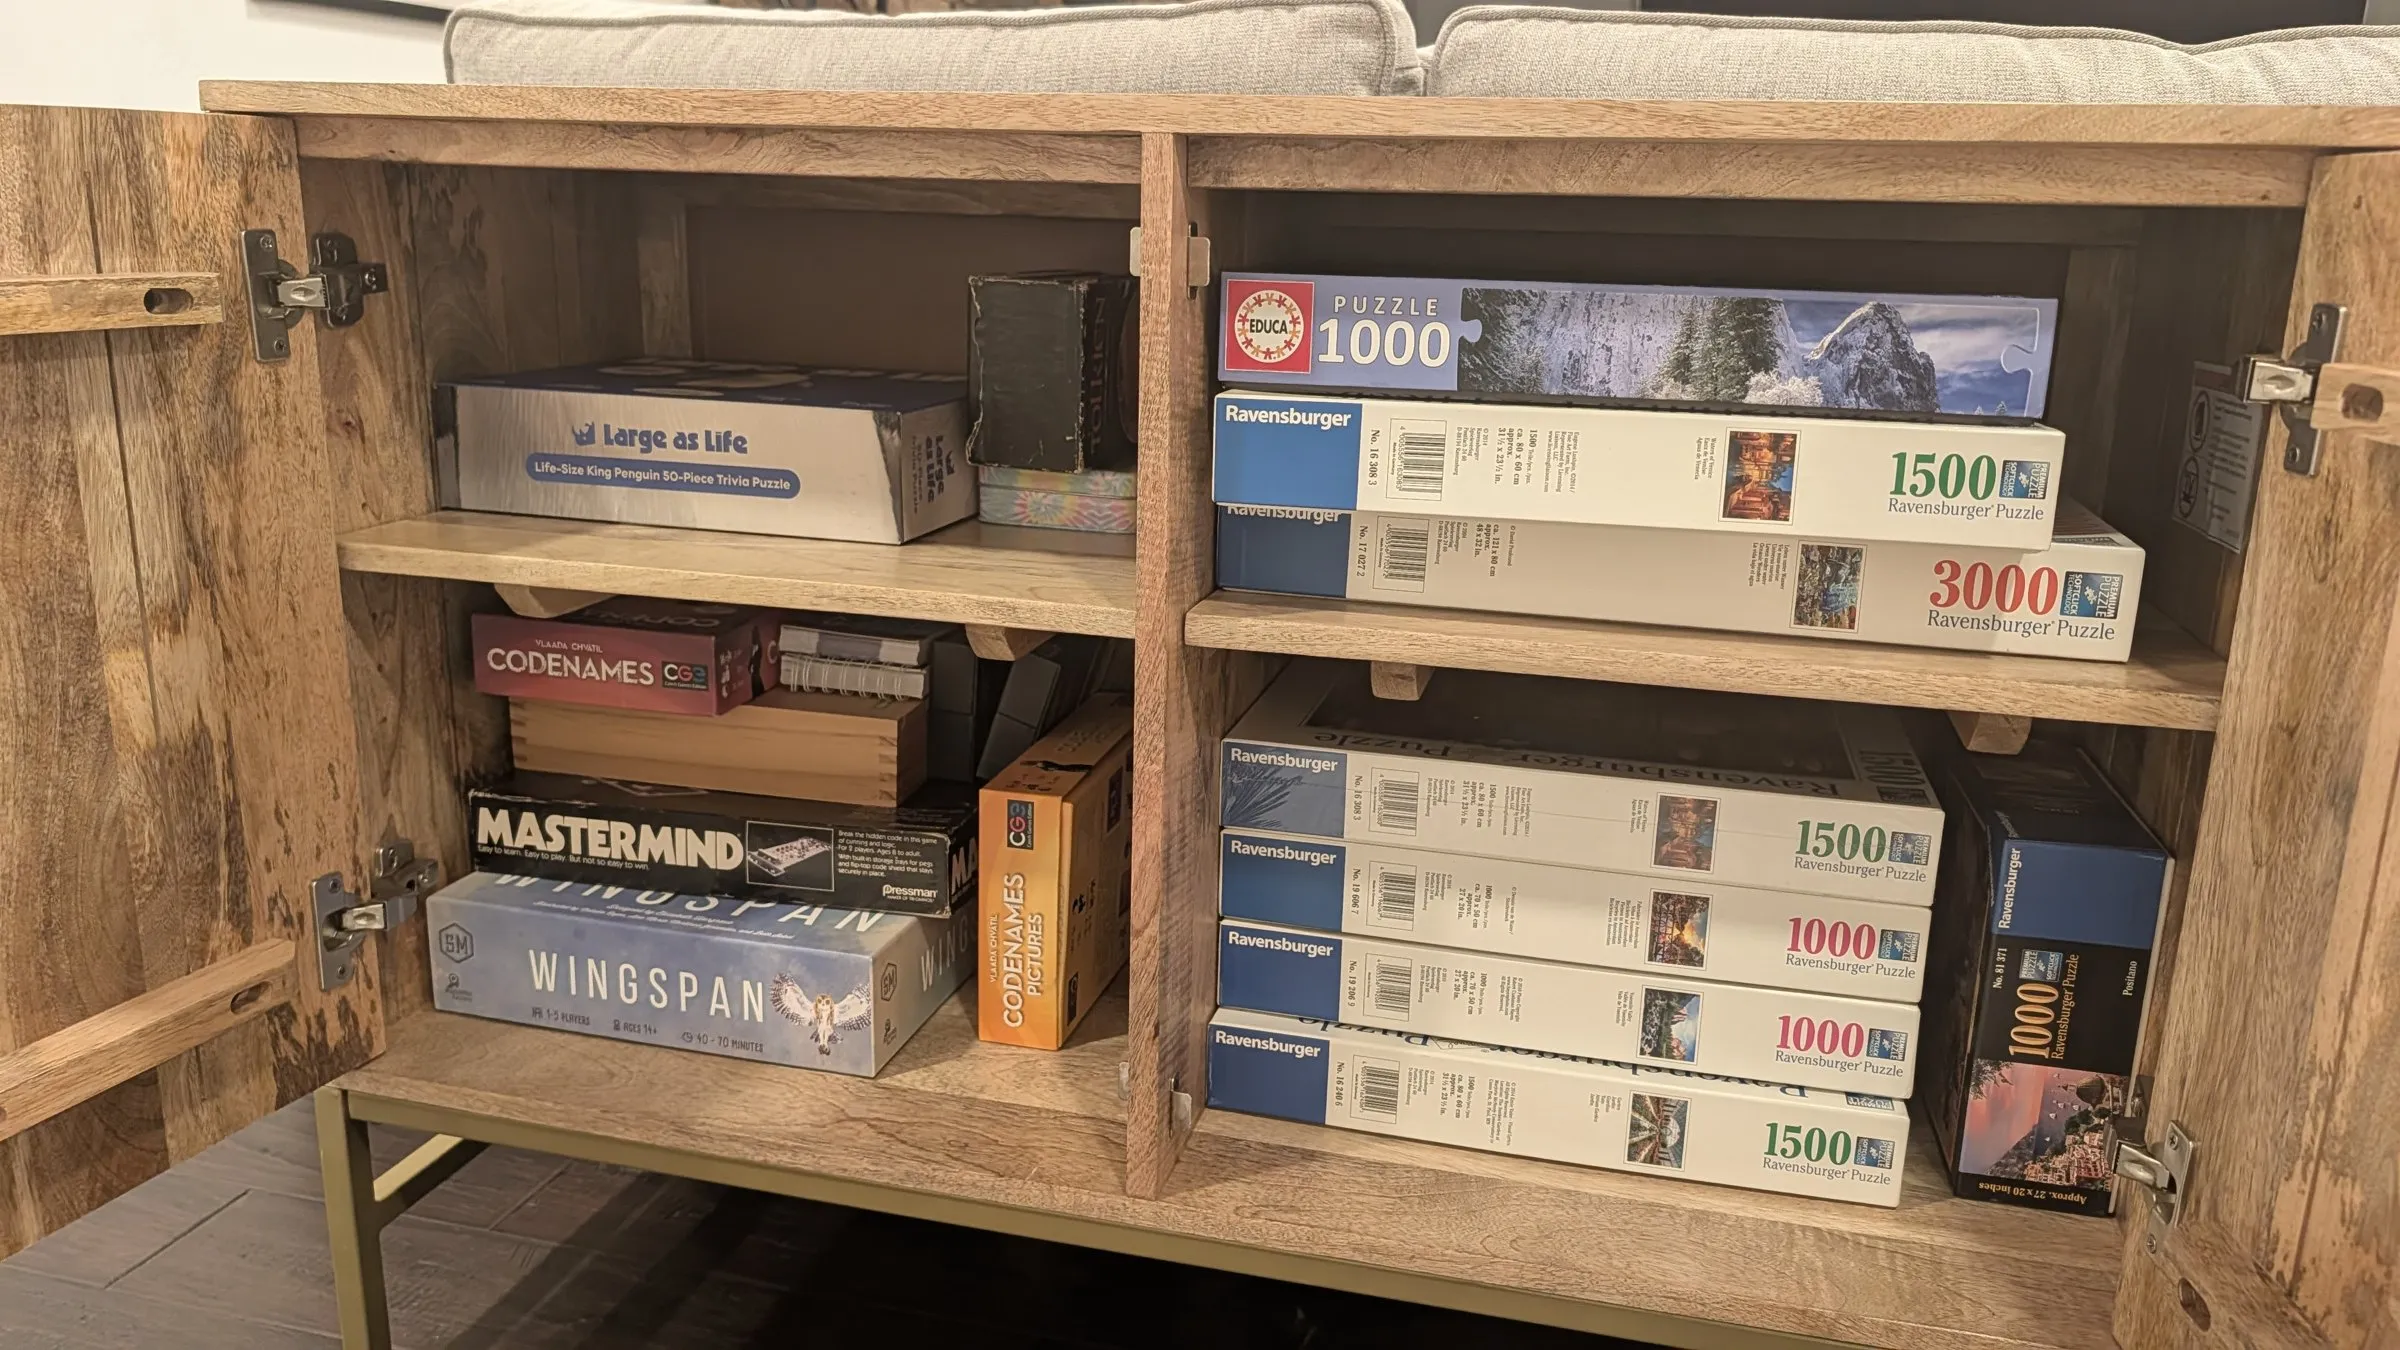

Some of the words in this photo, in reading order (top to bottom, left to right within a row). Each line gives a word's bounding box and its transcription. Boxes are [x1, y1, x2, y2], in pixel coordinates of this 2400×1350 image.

[1333, 295, 1438, 316] PUZZLE
[1249, 318, 1288, 335] EDUCA
[1318, 318, 1450, 368] 1000
[1226, 404, 1352, 430] Ravensburger
[604, 424, 667, 454] Large
[672, 431, 699, 451] as
[704, 430, 748, 454] Life
[1370, 429, 1380, 445] No.
[1506, 428, 1514, 458] approx.
[1515, 442, 1524, 452] 80
[1370, 448, 1379, 459] 16
[535, 461, 584, 476] Life-Size
[587, 465, 612, 480] King
[614, 468, 660, 483] Penguin
[662, 470, 714, 485] 50-Piece
[717, 474, 750, 488] Trivia
[752, 477, 791, 490] Puzzle
[1369, 461, 1379, 478] 308
[1514, 461, 1522, 471] 60
[1889, 451, 1997, 500] 1500
[1513, 473, 1520, 485] cm
[2028, 462, 2041, 498] PUZZLE
[2038, 463, 2048, 498] PREMIUM
[1888, 498, 1992, 520] Ravensburger
[1995, 506, 2044, 520] Puzzle
[1358, 525, 1368, 540] No.
[1358, 542, 1367, 553] 17
[1357, 554, 1367, 570] 027
[1929, 559, 2059, 615] 3000
[2096, 575, 2112, 617] PUZZLE
[2106, 576, 2120, 617] PREMIUM
[1927, 609, 2052, 638] Ravensburger
[2056, 619, 2115, 640] Puzzle
[535, 639, 568, 650] VLAADA
[487, 647, 655, 686] CODENAMES
[1230, 747, 1338, 774] Ravensburger
[1354, 775, 1363, 788] No.
[1354, 790, 1362, 799] 16
[477, 806, 744, 871] MASTERMIND
[1795, 820, 1887, 863] 1500
[524, 850, 540, 860] Easy
[541, 852, 549, 860] to
[569, 854, 582, 863] But
[583, 857, 595, 865] not
[624, 861, 633, 869] to
[1230, 839, 1337, 867] Ravensburger
[1351, 868, 1361, 882] No.
[1794, 856, 1882, 879] Ravensburger
[1885, 866, 1927, 882] Puzzle
[882, 884, 937, 898] Pressman
[1352, 882, 1361, 894] 19
[1998, 848, 2022, 930] Ravensburger
[1351, 894, 1360, 908] 606
[1003, 873, 1026, 1028] CODENAMES
[1228, 931, 1333, 957] Ravensburger
[1786, 917, 1876, 960] 1000
[989, 950, 998, 983] VLAADA
[1027, 913, 1044, 996] PICTURES
[1349, 960, 1358, 973] No.
[1786, 953, 1872, 975] Ravensburger
[1875, 963, 1916, 979] Puzzle
[1996, 947, 2008, 962] 371
[2027, 950, 2039, 979] PUZZLE
[1348, 975, 1357, 985] 19
[1995, 963, 2005, 974] 81
[2061, 953, 2079, 988] Puzzle
[2122, 960, 2138, 996] Positano
[529, 948, 766, 1023] WINGSPAN
[1347, 986, 1356, 1000] 206
[1992, 975, 2004, 989] No.
[561, 1011, 590, 1026] PLAYERS
[623, 1022, 641, 1034] AGES
[2008, 983, 2059, 1059] 1000
[2051, 989, 2076, 1060] Ravensburger
[718, 1036, 730, 1048] 70
[731, 1039, 764, 1053] MINUTES
[1215, 1029, 1321, 1059] Ravensburger
[1776, 1015, 1865, 1058] 1000
[1336, 1061, 1345, 1075] No.
[1775, 1051, 1861, 1073] Ravensburger
[1863, 1060, 1904, 1078] Puzzle
[1335, 1076, 1344, 1086] 16
[1335, 1087, 1344, 1100] 240
[1763, 1122, 1851, 1166] 1500
[1762, 1157, 1848, 1180] Ravensburger
[1851, 1169, 1891, 1186] Puzzle
[1979, 1181, 2012, 1195] inches
[2012, 1187, 2026, 1196] 20
[2033, 1190, 2046, 1199] 27
[2049, 1191, 2088, 1205] Approx.
